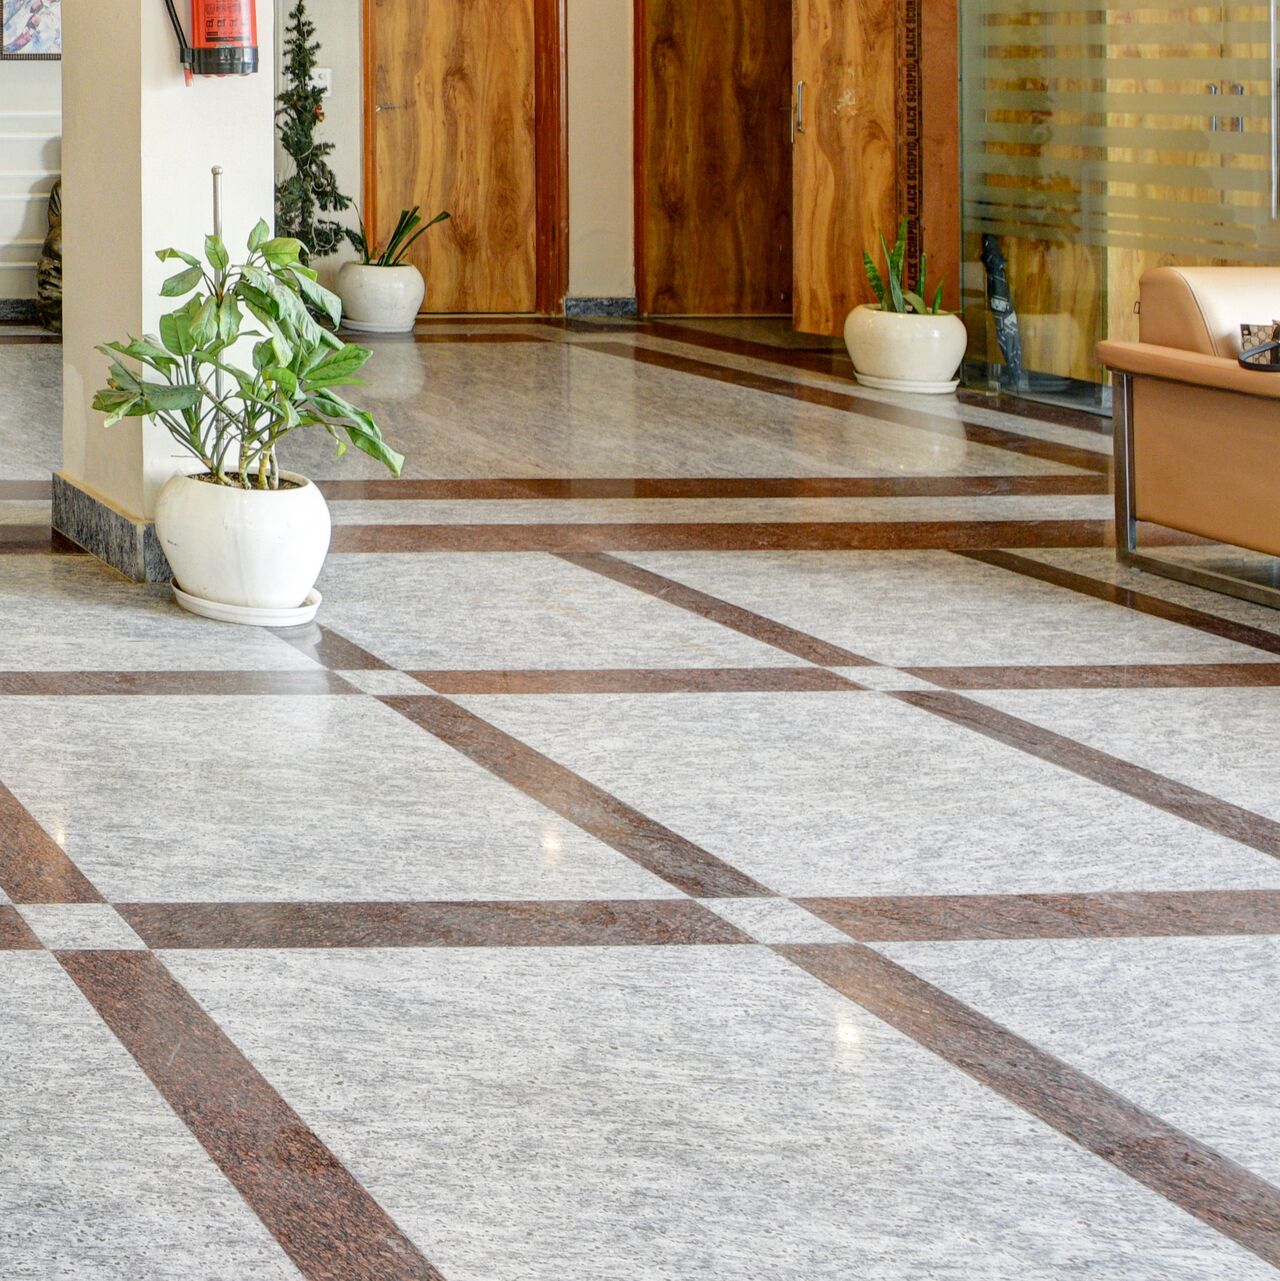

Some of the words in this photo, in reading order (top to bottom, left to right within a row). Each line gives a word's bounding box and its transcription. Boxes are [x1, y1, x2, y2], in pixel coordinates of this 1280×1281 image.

[906, 27, 917, 59] BLACK
[907, 105, 918, 137] BLACK
[907, 184, 918, 215] BLACK
